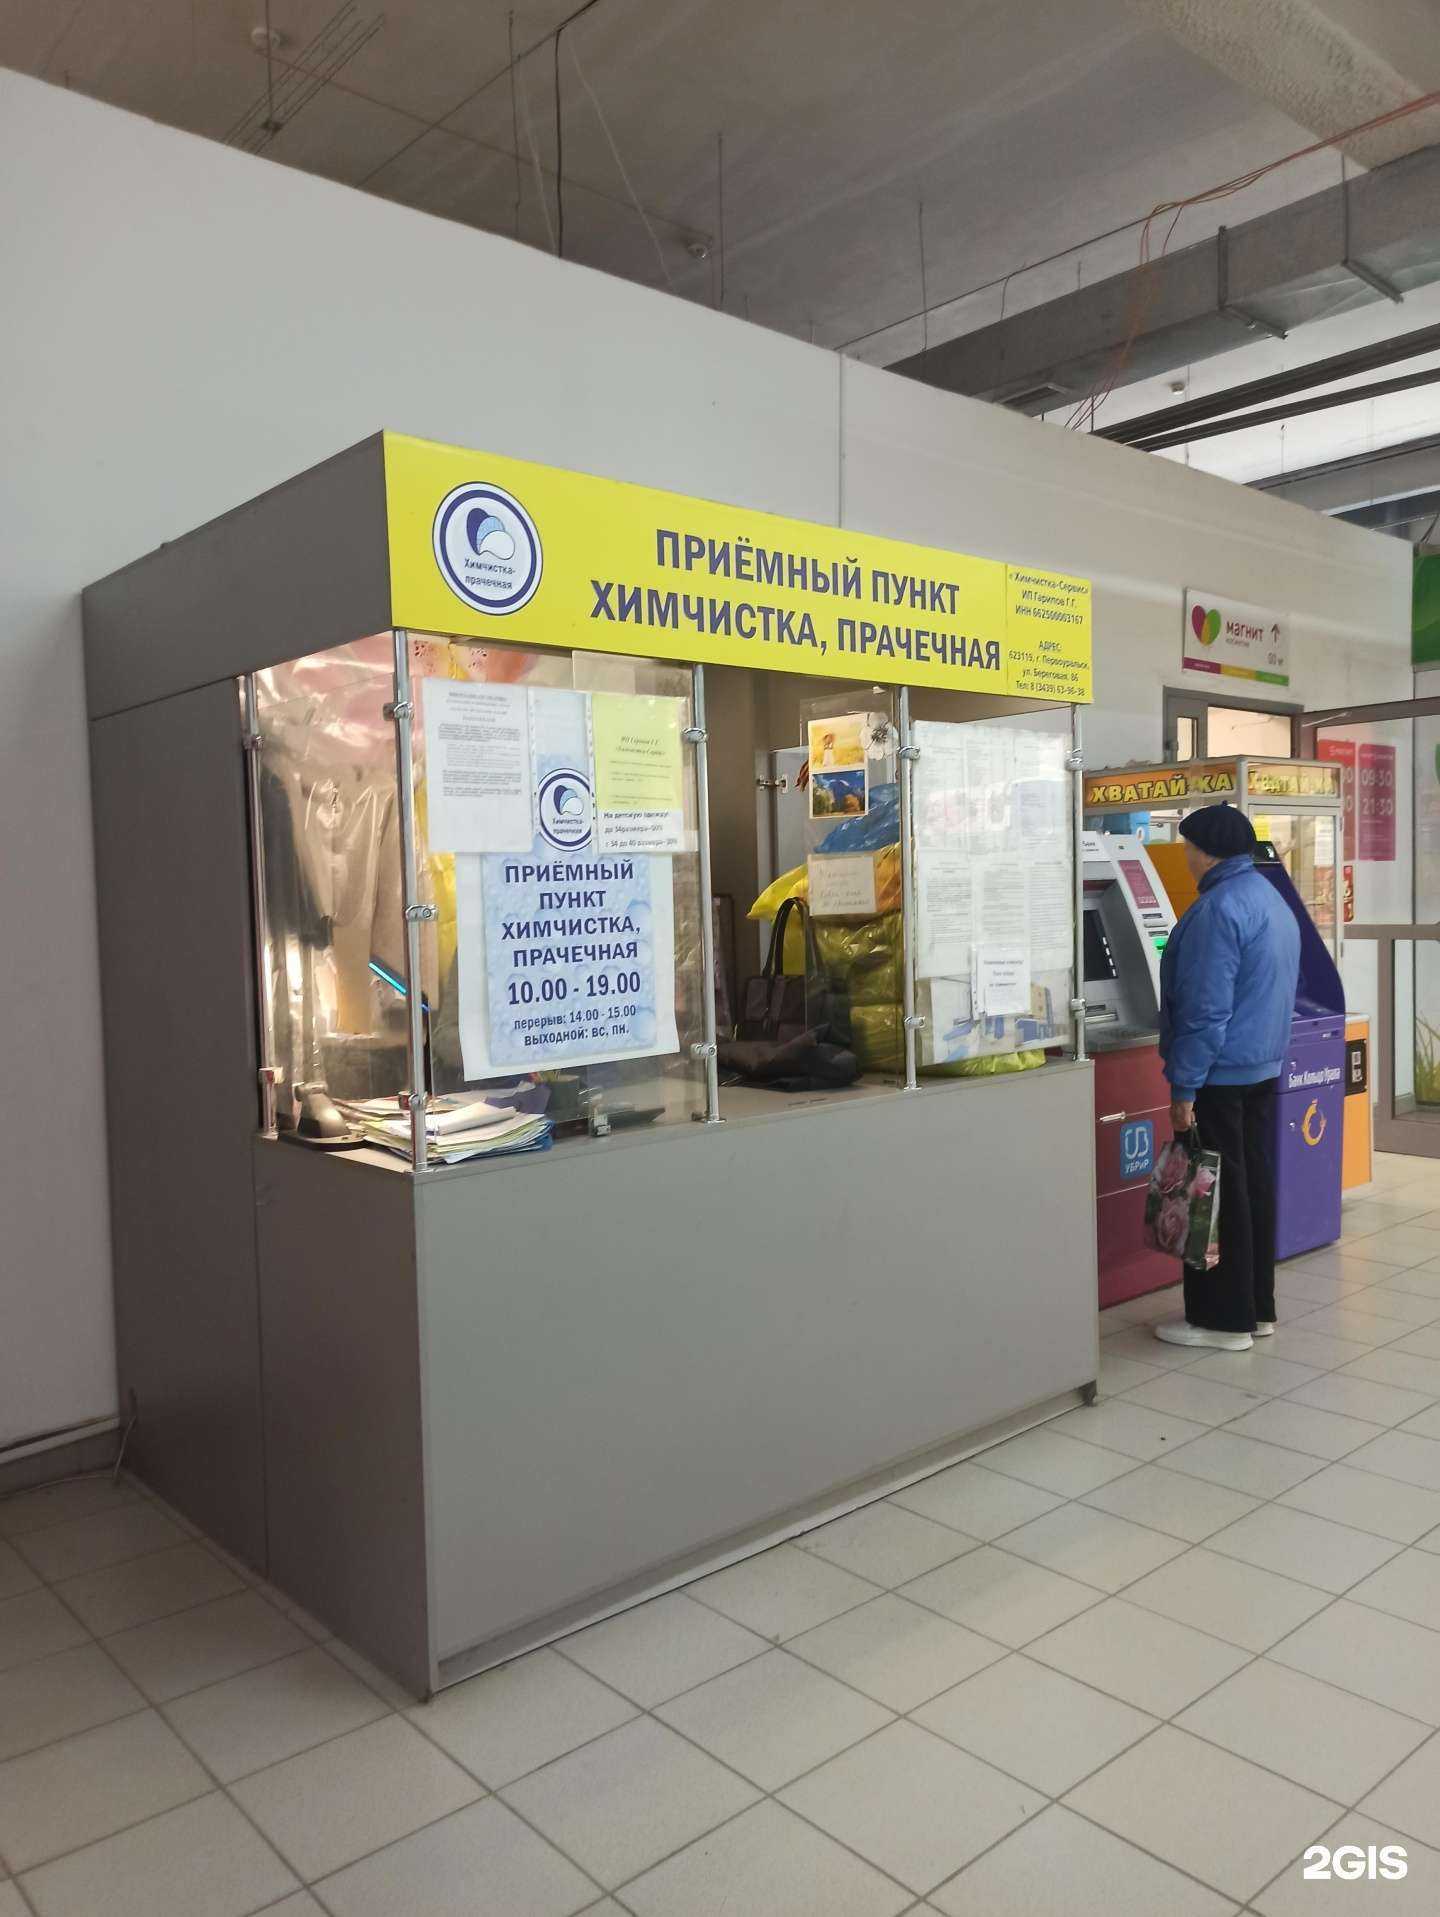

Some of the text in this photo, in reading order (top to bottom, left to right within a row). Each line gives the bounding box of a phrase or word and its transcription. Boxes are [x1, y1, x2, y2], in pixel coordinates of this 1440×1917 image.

[464, 558, 516, 575] Химчистка-
[656, 529, 960, 615] ПРИЁМНЫЙ ПУНКТ
[465, 575, 513, 590] прачечная
[1015, 604, 1032, 617] ИНН
[590, 579, 1001, 671] ХИМЧИСТКА, ПРАЧЕЧНАЯ
[1226, 620, 1264, 642] магнит
[505, 859, 634, 884] ПРИЁМНЫЙ
[539, 890, 607, 910] ПУНКТ
[501, 916, 641, 941] ХИМЧИСТКА,
[513, 941, 638, 968] ПРАЧЕЧНАЯ
[508, 978, 568, 1006] 10.00
[586, 971, 641, 998] 19.00
[514, 1014, 567, 1031] перерыв:
[569, 1008, 599, 1024] 14.00
[608, 1004, 637, 1019] 15.00
[524, 1027, 589, 1047] выходной:
[612, 1023, 631, 1036] пн.
